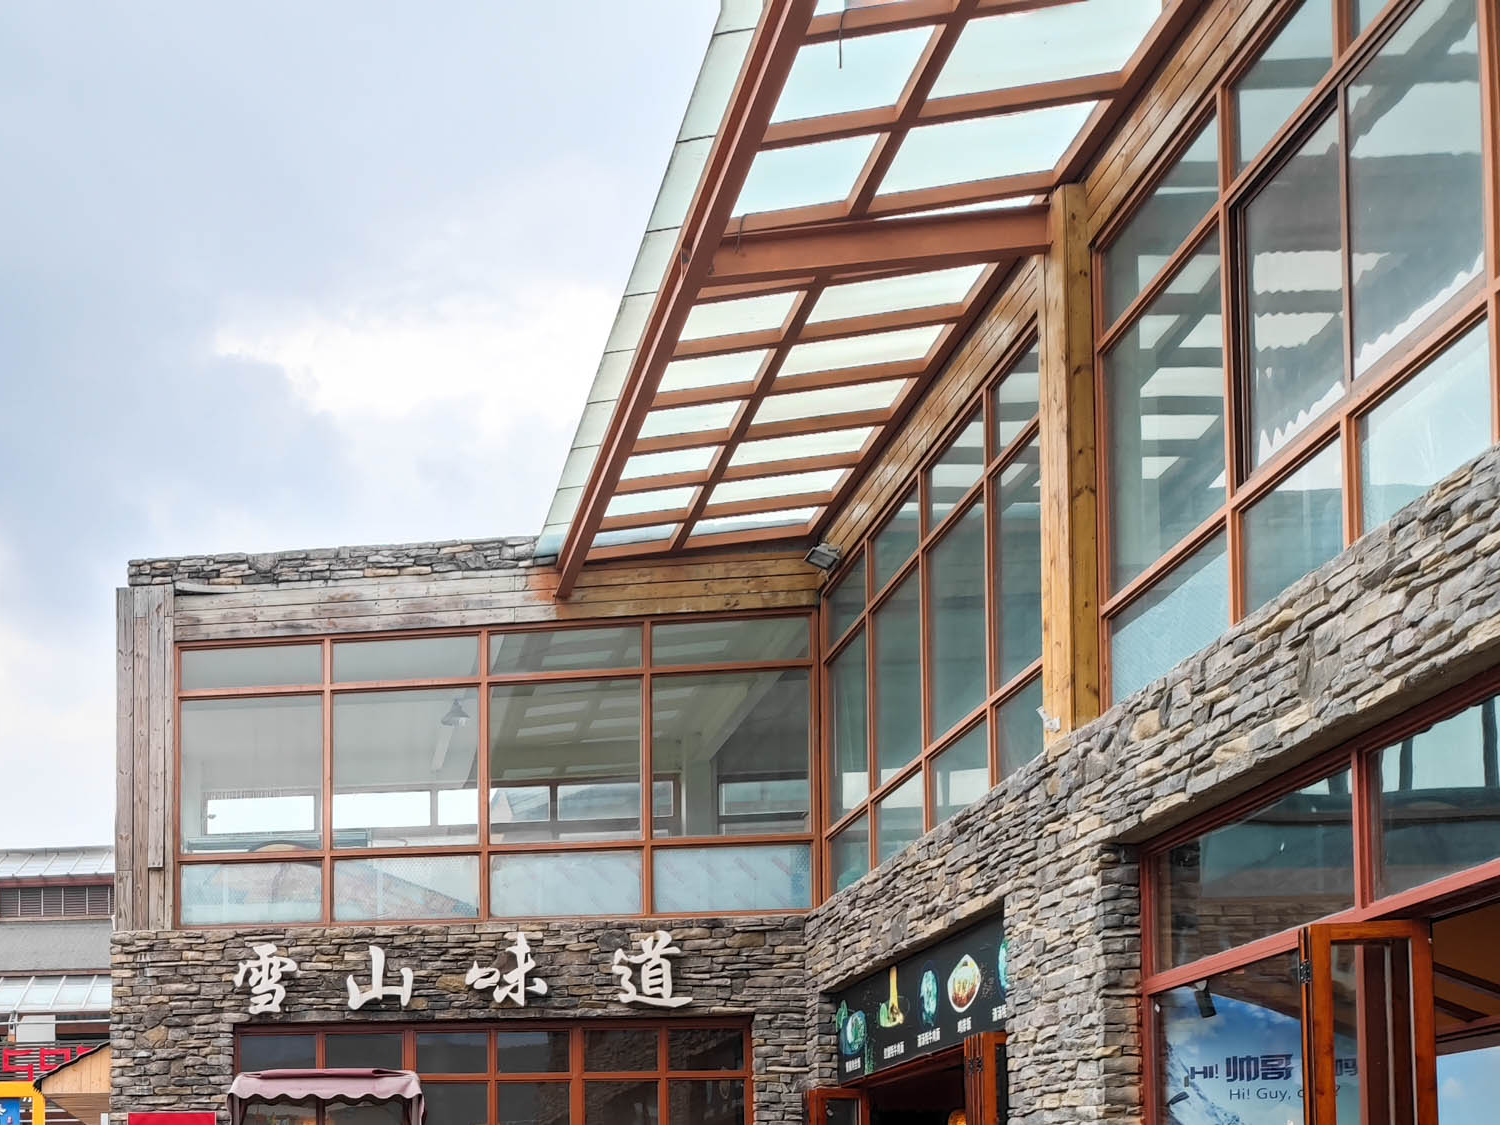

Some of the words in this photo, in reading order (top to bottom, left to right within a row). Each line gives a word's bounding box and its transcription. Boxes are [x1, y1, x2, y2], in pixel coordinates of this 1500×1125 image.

[233, 930, 693, 1015] 雪山味道
[1225, 1053, 1293, 1082] 帅哥
[1229, 1088, 1250, 1101] Hi!
[1256, 1088, 1292, 1103] Guy,
